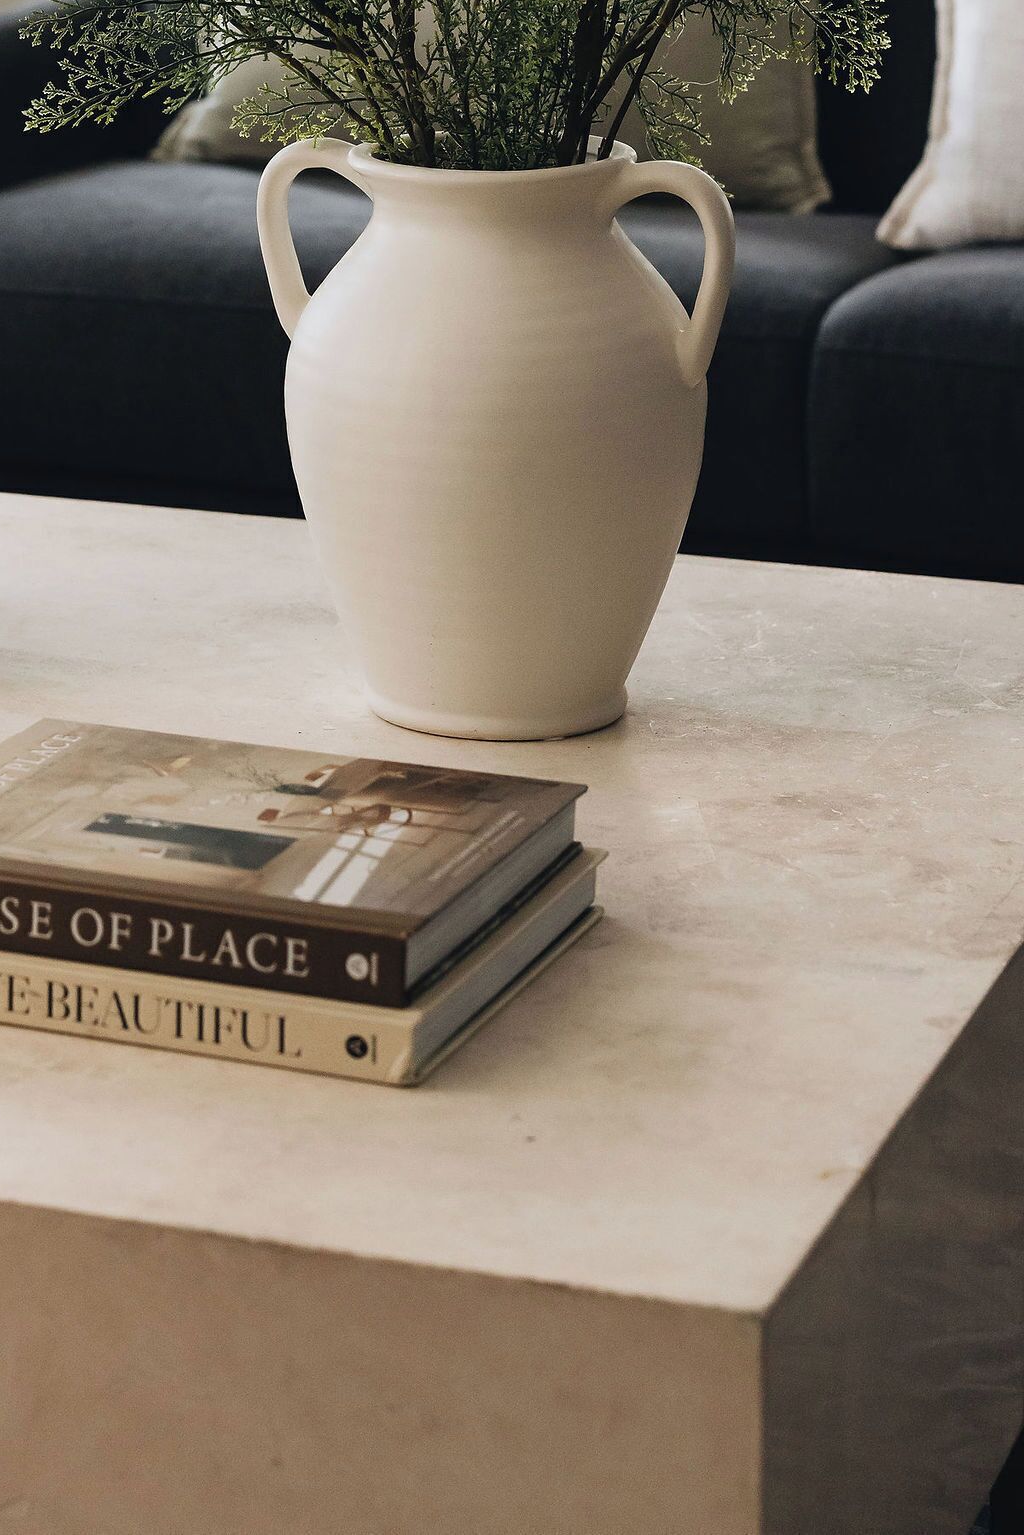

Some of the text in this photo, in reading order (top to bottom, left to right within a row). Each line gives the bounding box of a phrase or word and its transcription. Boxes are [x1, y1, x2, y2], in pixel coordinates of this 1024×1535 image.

[14, 732, 82, 772] PLACE
[69, 906, 133, 951] OF
[148, 917, 311, 979] PLACE
[45, 978, 303, 1060] BEAUTIFUL
